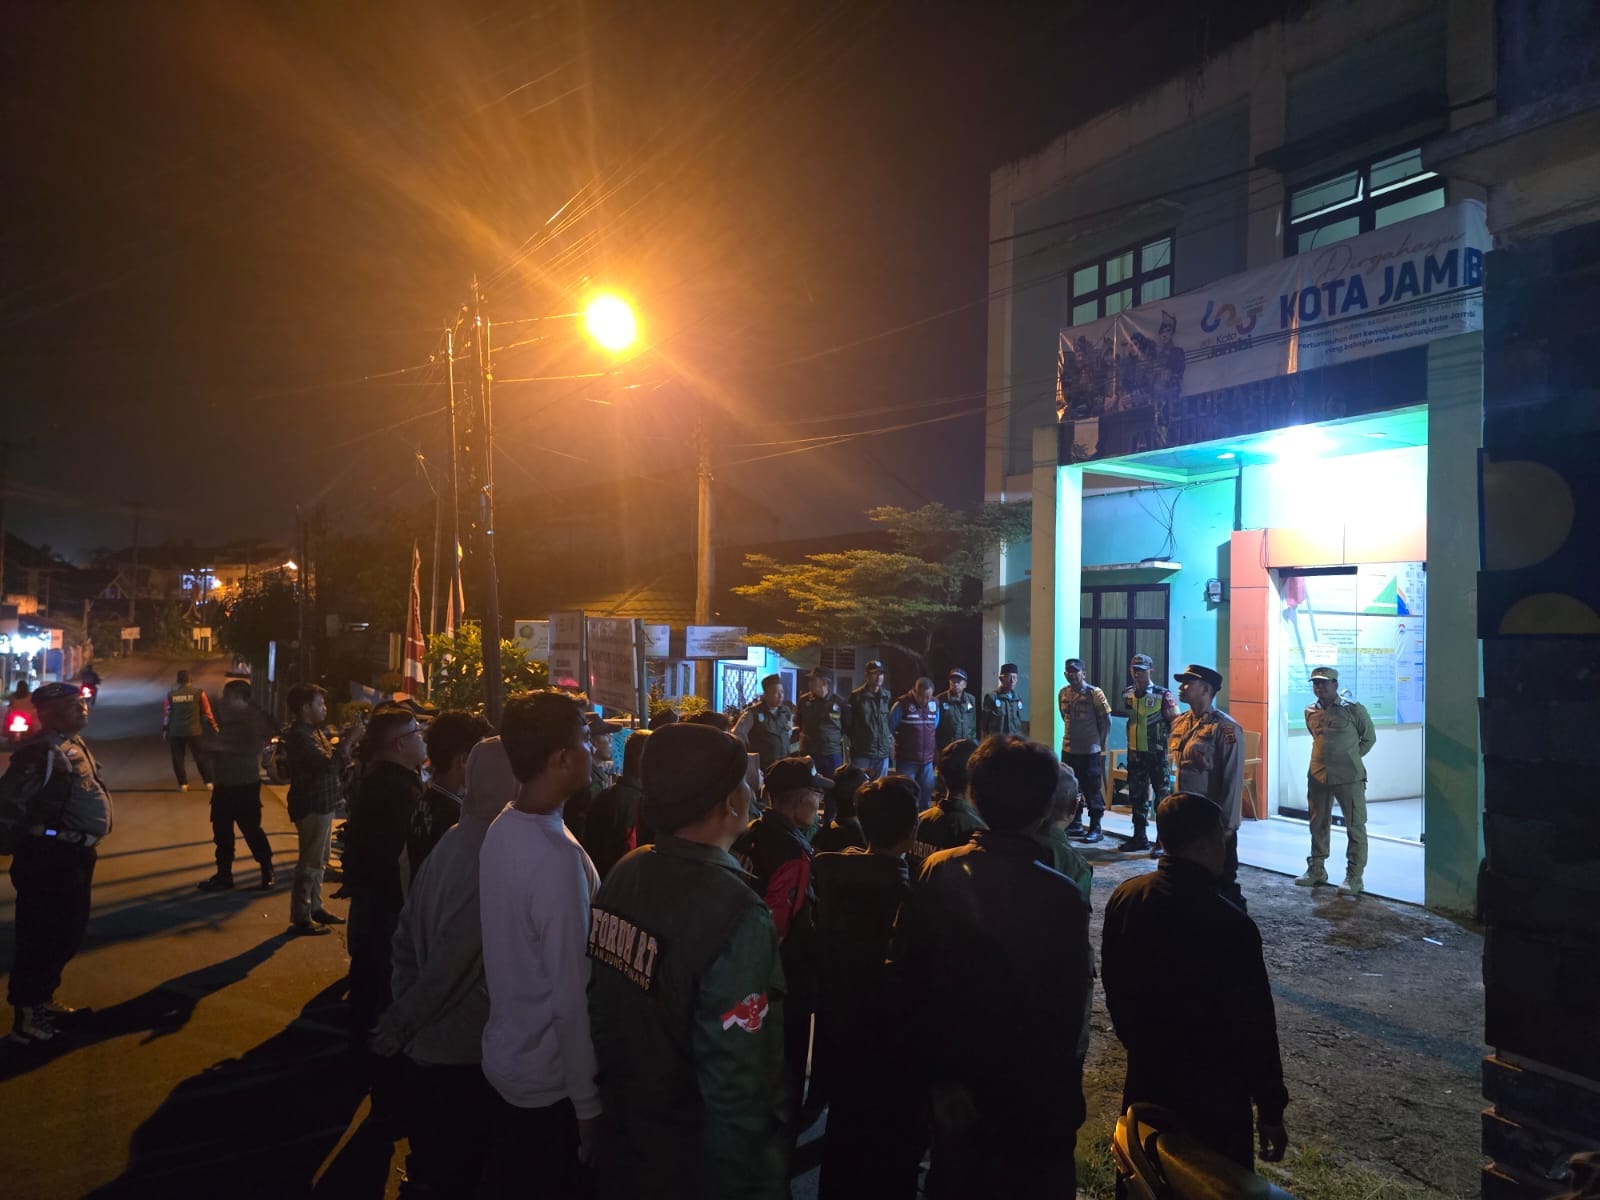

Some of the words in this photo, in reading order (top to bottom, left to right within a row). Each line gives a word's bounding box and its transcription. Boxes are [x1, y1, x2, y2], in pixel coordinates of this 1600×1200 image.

[1313, 232, 1466, 280] Dirgahayu
[1280, 273, 1368, 329] KOTA
[1216, 332, 1237, 345] Kota
[589, 908, 637, 965] FORUM
[634, 930, 658, 978] RT
[589, 943, 623, 972] TANJUNG
